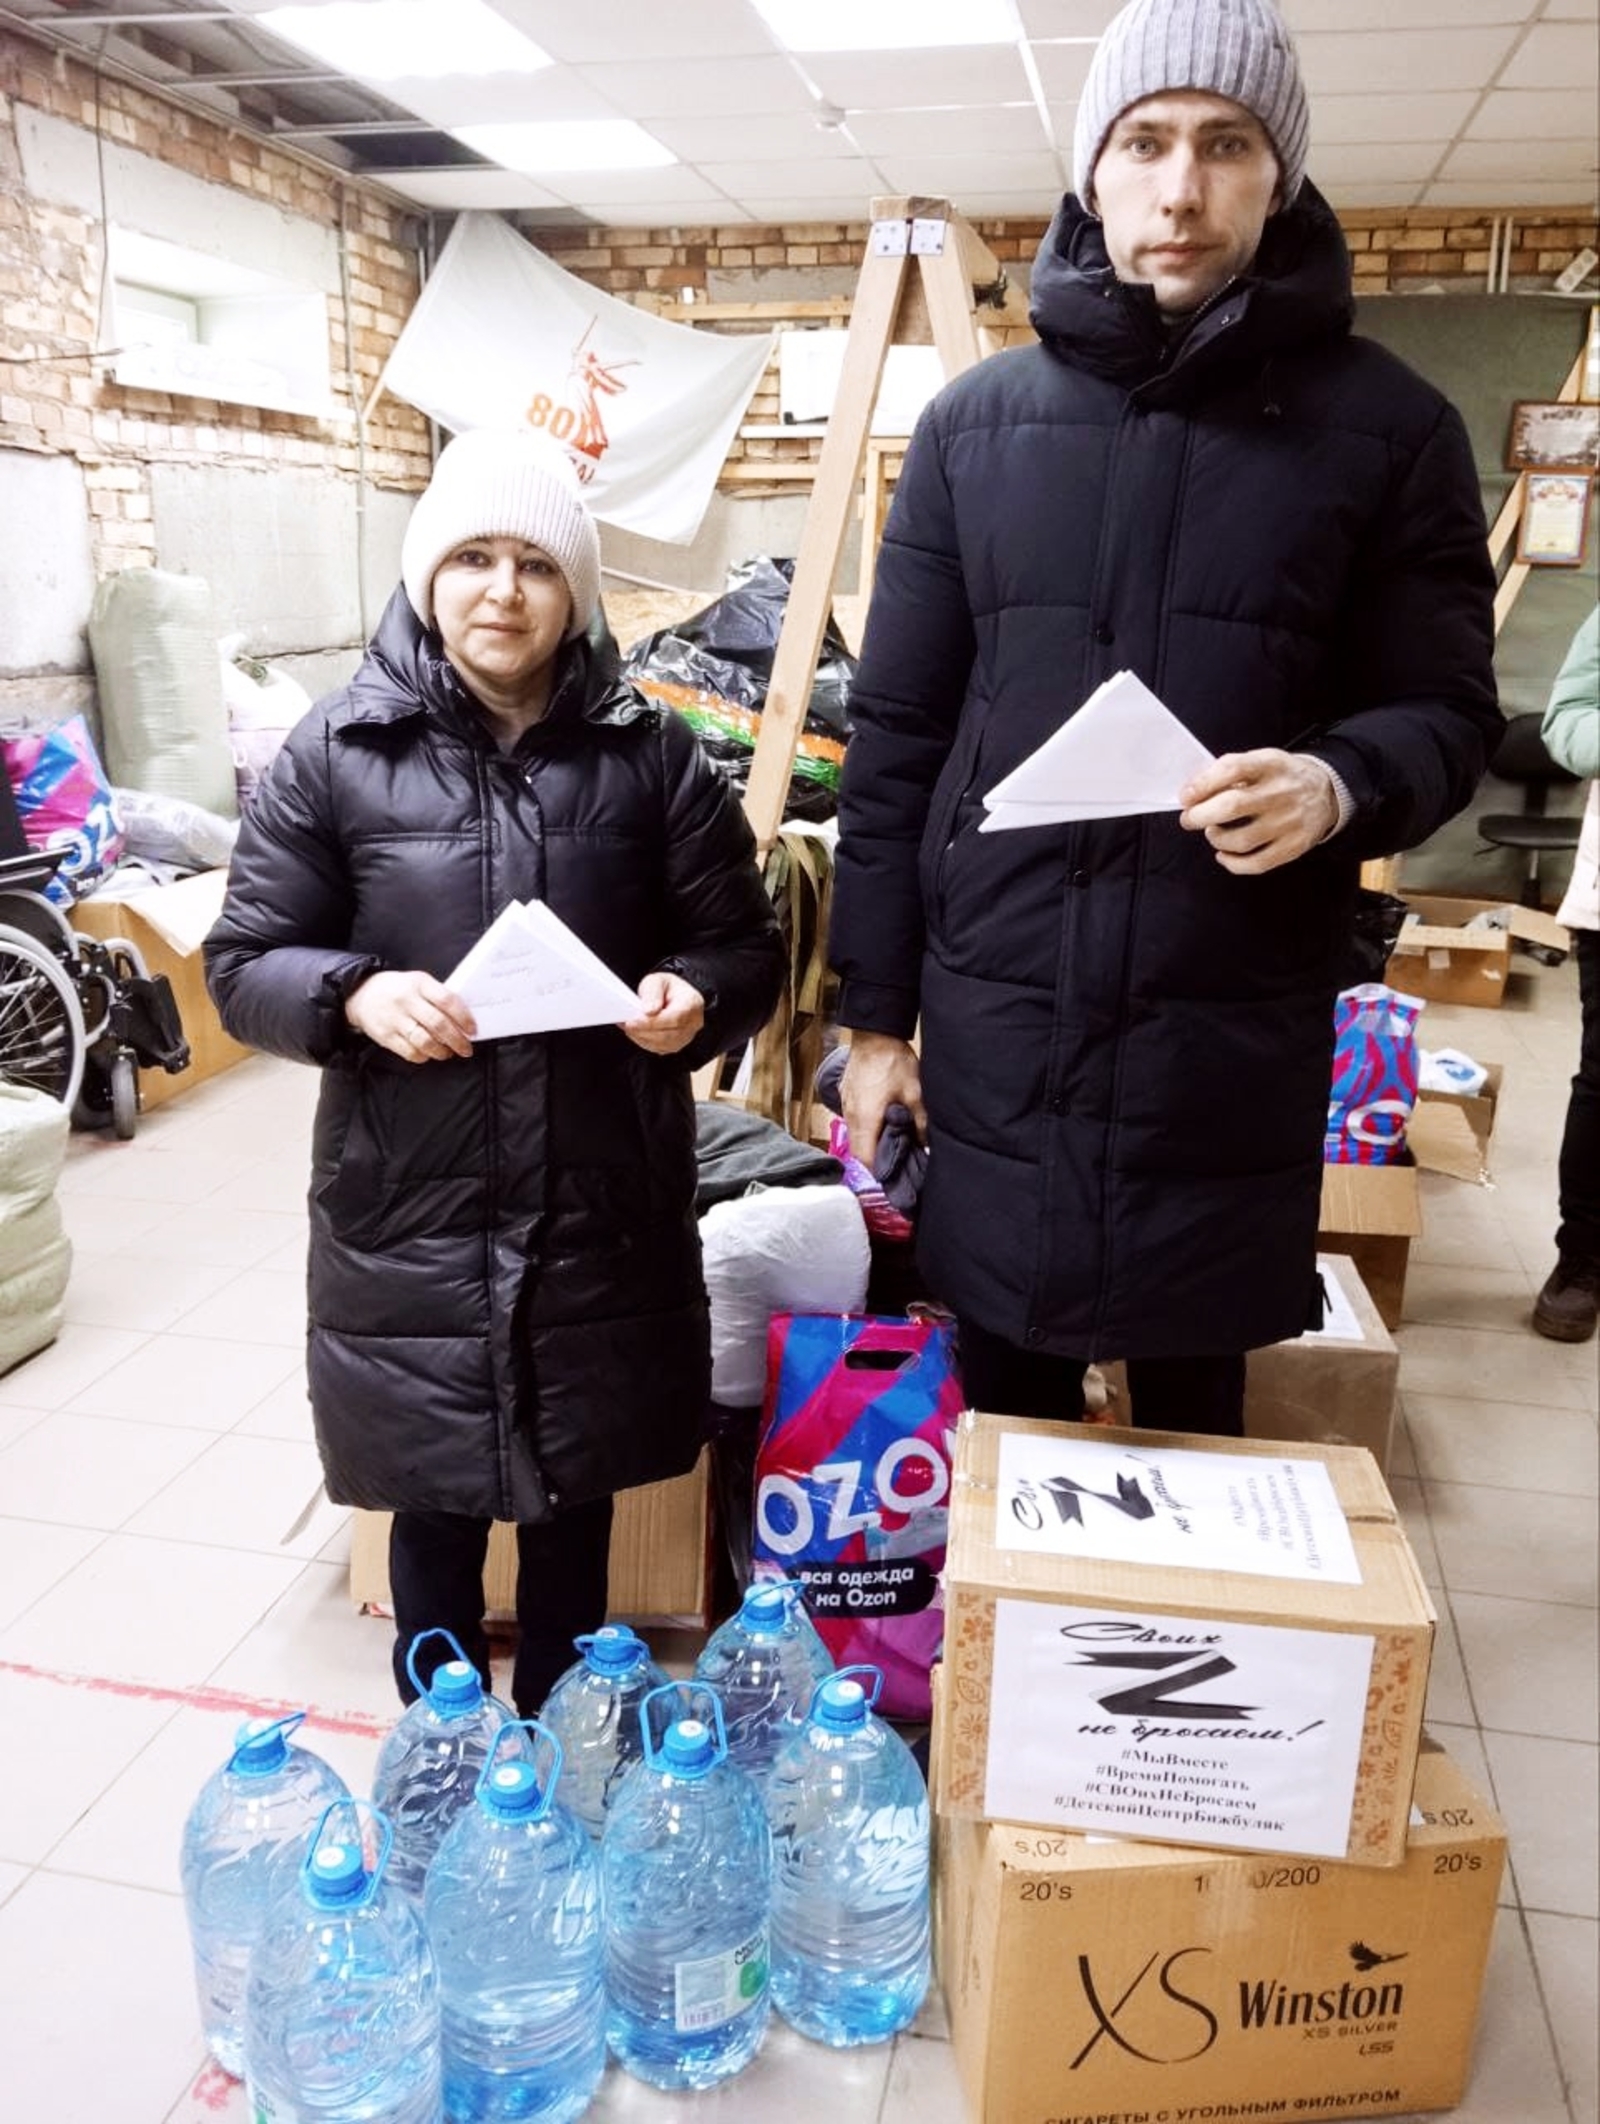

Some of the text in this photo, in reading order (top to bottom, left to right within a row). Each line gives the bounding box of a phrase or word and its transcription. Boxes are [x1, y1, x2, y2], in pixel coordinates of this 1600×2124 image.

[526, 392, 576, 440] 80
[801, 1567, 915, 1587] вся одежда
[815, 1589, 897, 1607] на Ozon
[1060, 1621, 1223, 1644] Своих
[1077, 1718, 1326, 1743] не бросаем!
[1121, 1749, 1229, 1770] #МыВместе
[1096, 1765, 1250, 1791] #ВремяПомогать
[1085, 1781, 1257, 1811] #СВОихНеБросаем
[1433, 1852, 1482, 1875] 20's
[1020, 1881, 1072, 1901] 20's
[1069, 1947, 1218, 2070] XS
[1238, 1979, 1403, 2030] Winston
[1337, 2020, 1398, 2037] SILVER
[1176, 2101, 1288, 2121] УГОЛЬНЫМ
[1293, 2089, 1401, 2110] ФИЛЬТРОМ
